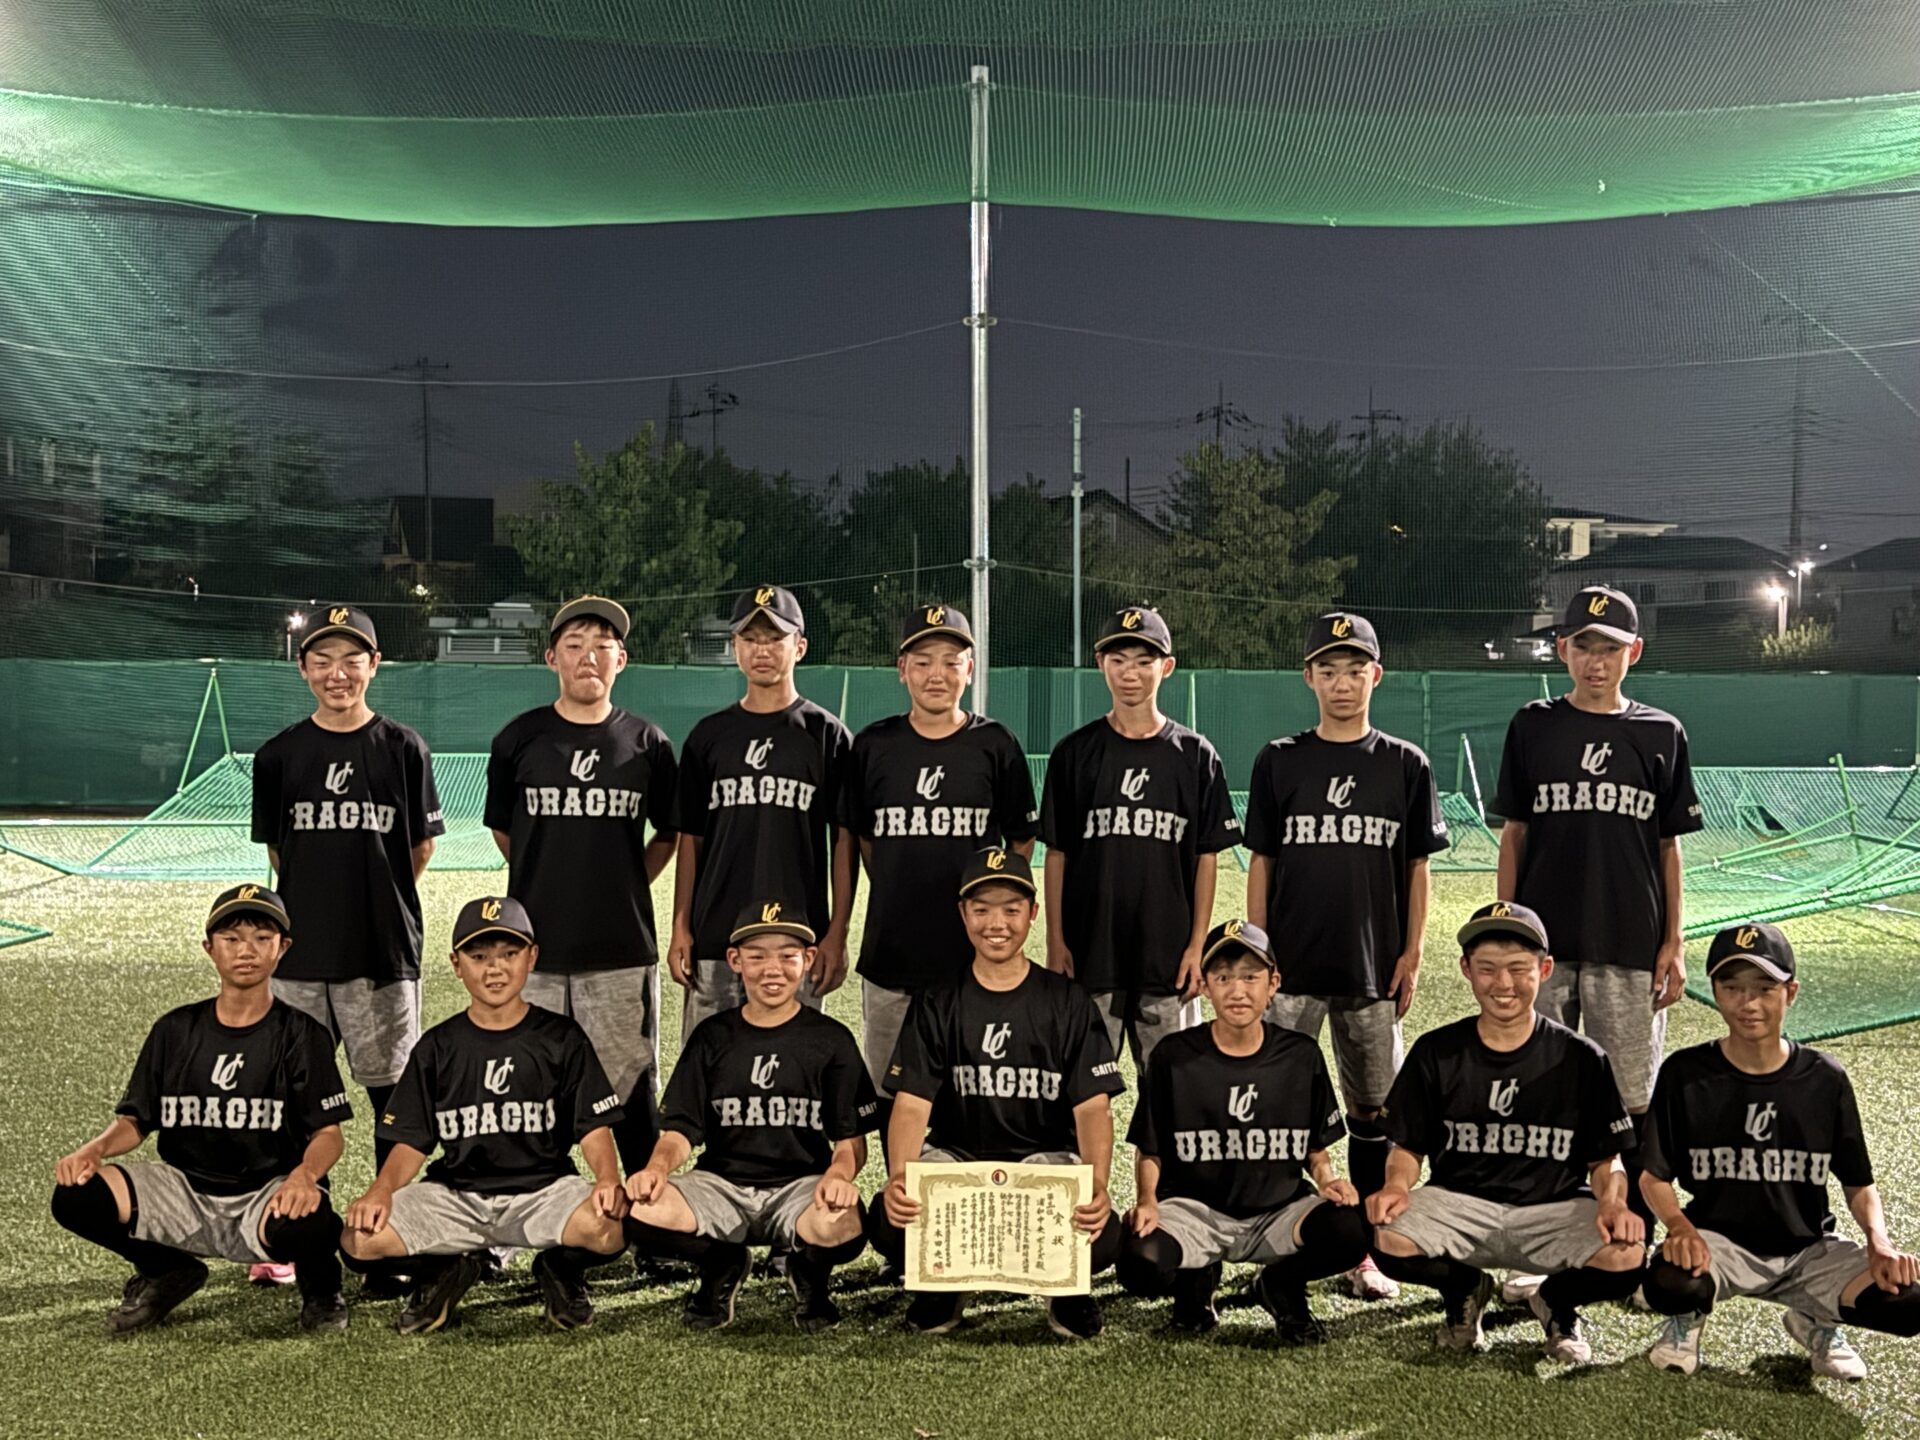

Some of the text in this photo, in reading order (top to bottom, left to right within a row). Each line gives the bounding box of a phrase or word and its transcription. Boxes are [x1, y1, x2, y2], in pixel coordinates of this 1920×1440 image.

[755, 588, 775, 606] UC
[1589, 596, 1609, 616] UC
[329, 608, 348, 625] UC
[926, 606, 945, 625] UC
[1122, 610, 1141, 629] UC
[1332, 617, 1350, 638] UC
[571, 749, 600, 781] UC
[745, 738, 773, 770] UC
[1581, 743, 1612, 775] UC
[325, 762, 353, 794] UC
[917, 766, 945, 800] UC
[1121, 768, 1150, 801] UC
[1327, 776, 1356, 808] UC
[290, 801, 395, 833] RACHU
[987, 851, 1006, 870] UC
[482, 900, 501, 921] UC
[762, 903, 781, 923] UC
[1224, 920, 1244, 936] UC
[1736, 928, 1759, 948] UC
[982, 1023, 1011, 1059] UC
[211, 1053, 244, 1090] UC
[484, 1057, 514, 1094] UC
[751, 1054, 779, 1089] UC
[1229, 1084, 1258, 1122] UC
[1489, 1079, 1519, 1116] UC
[1745, 1101, 1777, 1142] UC
[1174, 1128, 1310, 1161] URACHU
[1690, 1147, 1832, 1186] URACHU
